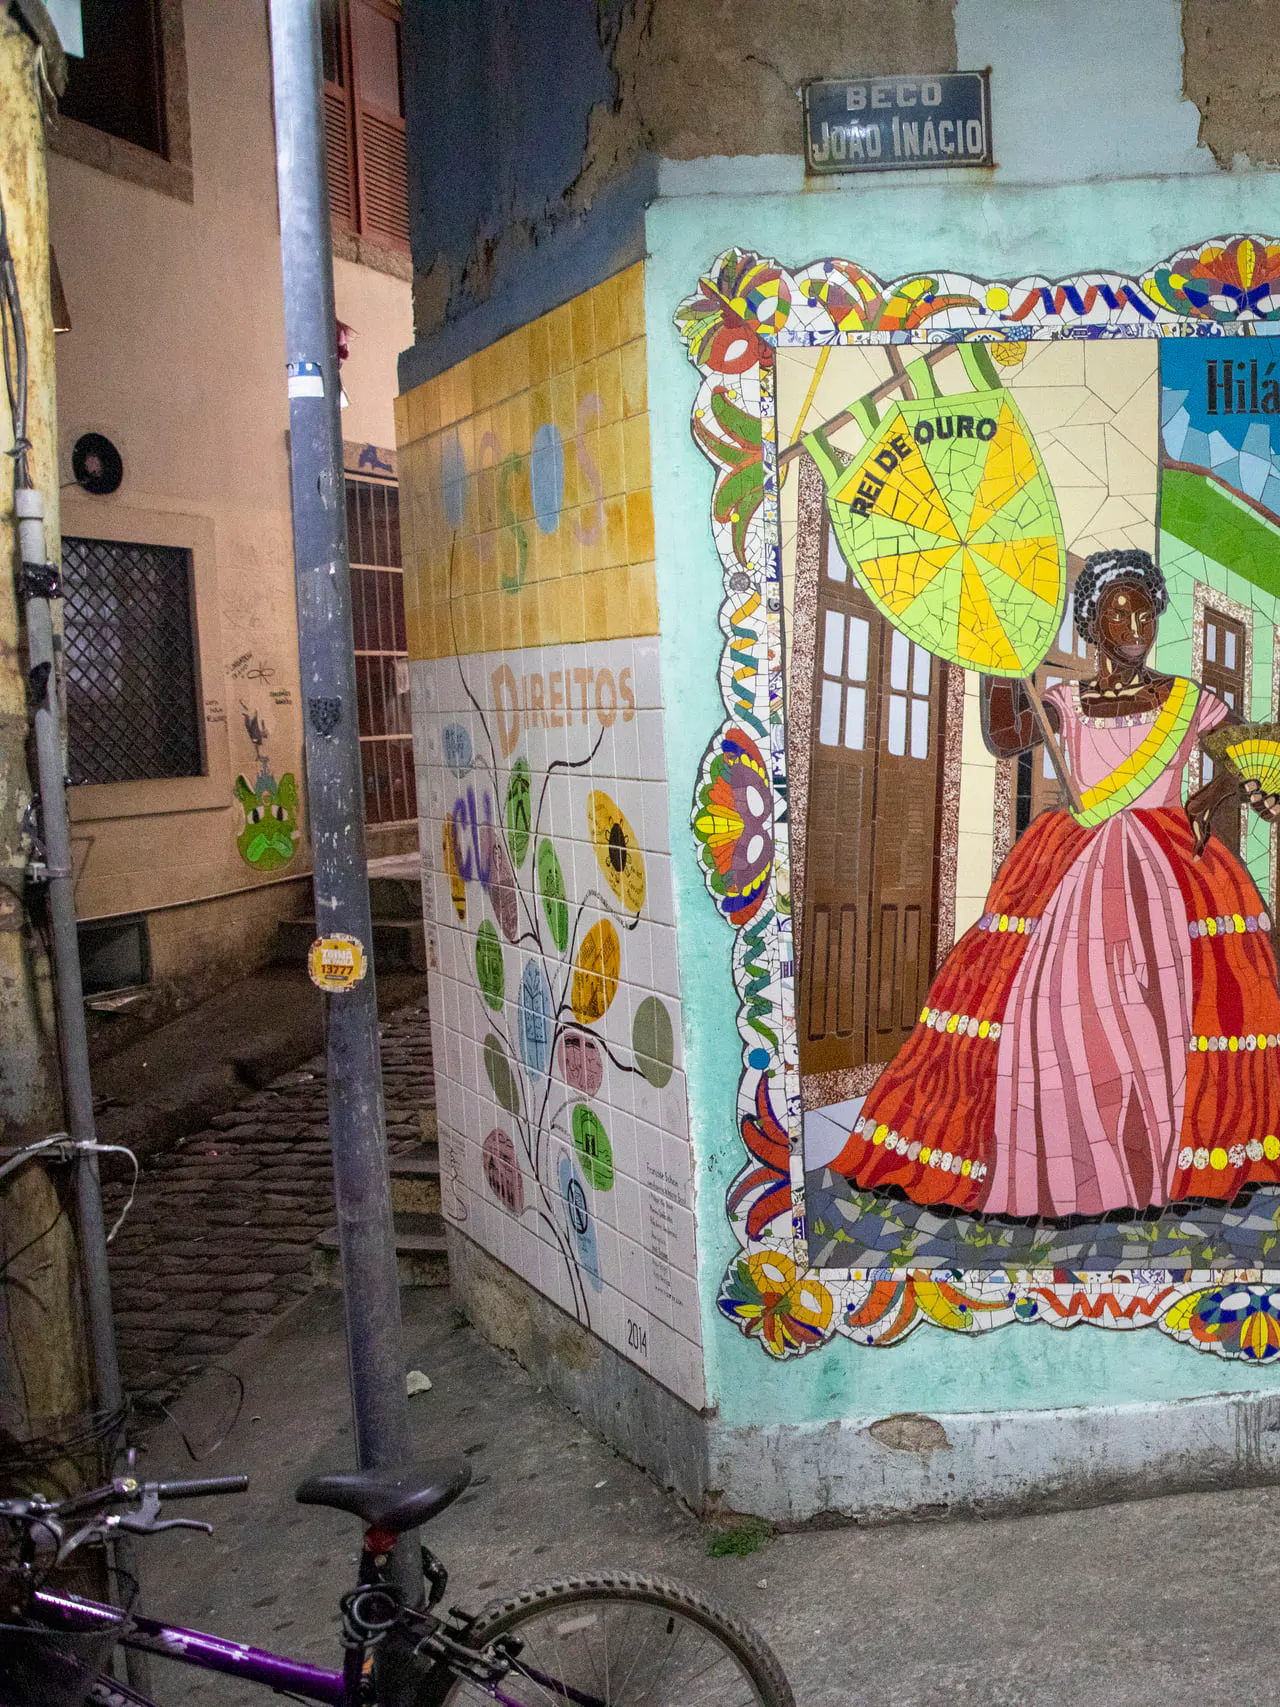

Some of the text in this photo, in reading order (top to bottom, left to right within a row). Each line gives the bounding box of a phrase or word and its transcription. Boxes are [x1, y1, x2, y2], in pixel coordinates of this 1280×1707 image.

[846, 82, 943, 111] BECO
[812, 116, 984, 162] JOÃO INÁCIO
[849, 415, 998, 519] REI DE OURO
[491, 662, 636, 760] DIREITOS
[321, 964, 354, 975] 13777
[627, 1318, 649, 1358] 2014
